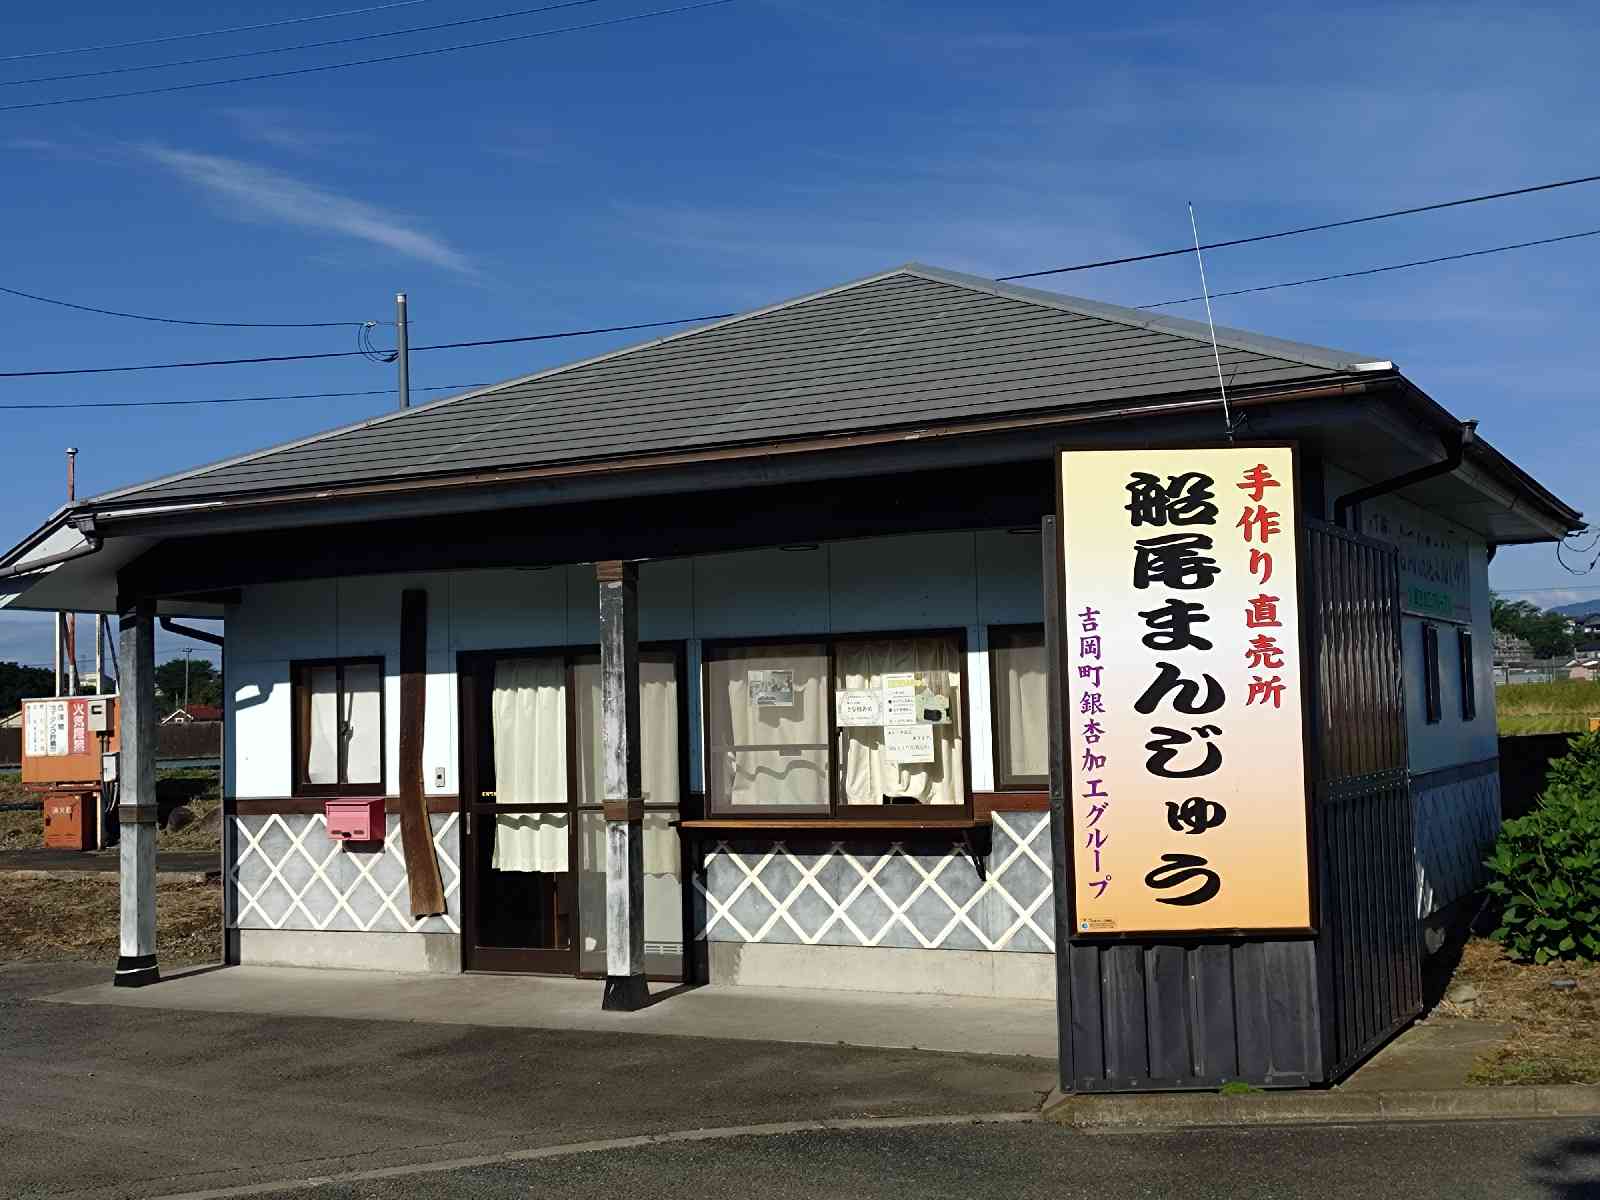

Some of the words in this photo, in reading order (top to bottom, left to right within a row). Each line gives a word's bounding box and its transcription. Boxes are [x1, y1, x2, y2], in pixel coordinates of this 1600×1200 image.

[1125, 471, 1226, 906] 船尾まんじゅう
[1235, 464, 1286, 708] 手作り直売所
[1078, 606, 1111, 899] 吉岡町銀杏加工グループ
